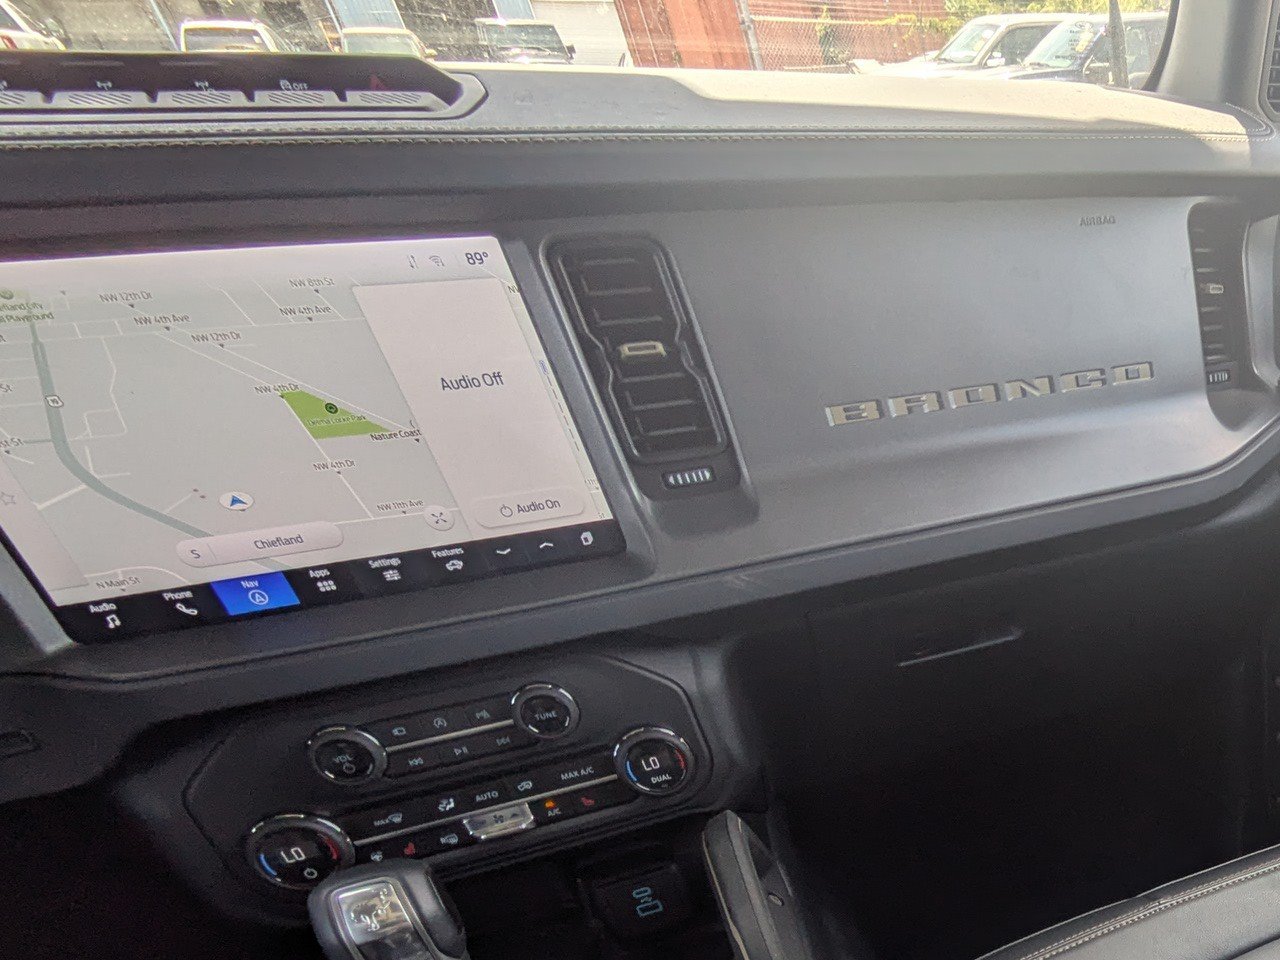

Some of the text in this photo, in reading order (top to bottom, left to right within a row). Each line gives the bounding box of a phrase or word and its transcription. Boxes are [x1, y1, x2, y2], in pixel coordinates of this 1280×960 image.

[289, 279, 306, 288] NW
[324, 277, 335, 286] St
[99, 293, 118, 302] NW
[279, 307, 297, 316] NW
[315, 305, 332, 314] Ave
[134, 314, 190, 325] NW 4th Ave
[191, 334, 209, 343] NW
[440, 371, 505, 391] Audio Off
[254, 385, 273, 394] NW
[288, 382, 299, 391] Dr
[825, 361, 1155, 427] BRONCO
[370, 429, 422, 442] Nature Coast
[313, 459, 356, 471] NW 4th Dr
[516, 499, 561, 514] Audio On
[253, 533, 304, 550] Chiefland
[190, 549, 200, 559] S
[431, 546, 465, 559] Features
[368, 556, 402, 570] Settings
[308, 567, 331, 579] Apps
[106, 578, 129, 588] Main
[128, 576, 140, 586] St
[240, 579, 260, 589] Nav
[162, 590, 194, 601] Phone
[88, 602, 118, 613] Audio
[534, 710, 558, 720] TUNE
[641, 756, 660, 771] LO
[560, 766, 595, 780] MAX A/C
[651, 773, 673, 784] DUAL
[475, 790, 499, 802] AUTO
[281, 846, 306, 863] LO
